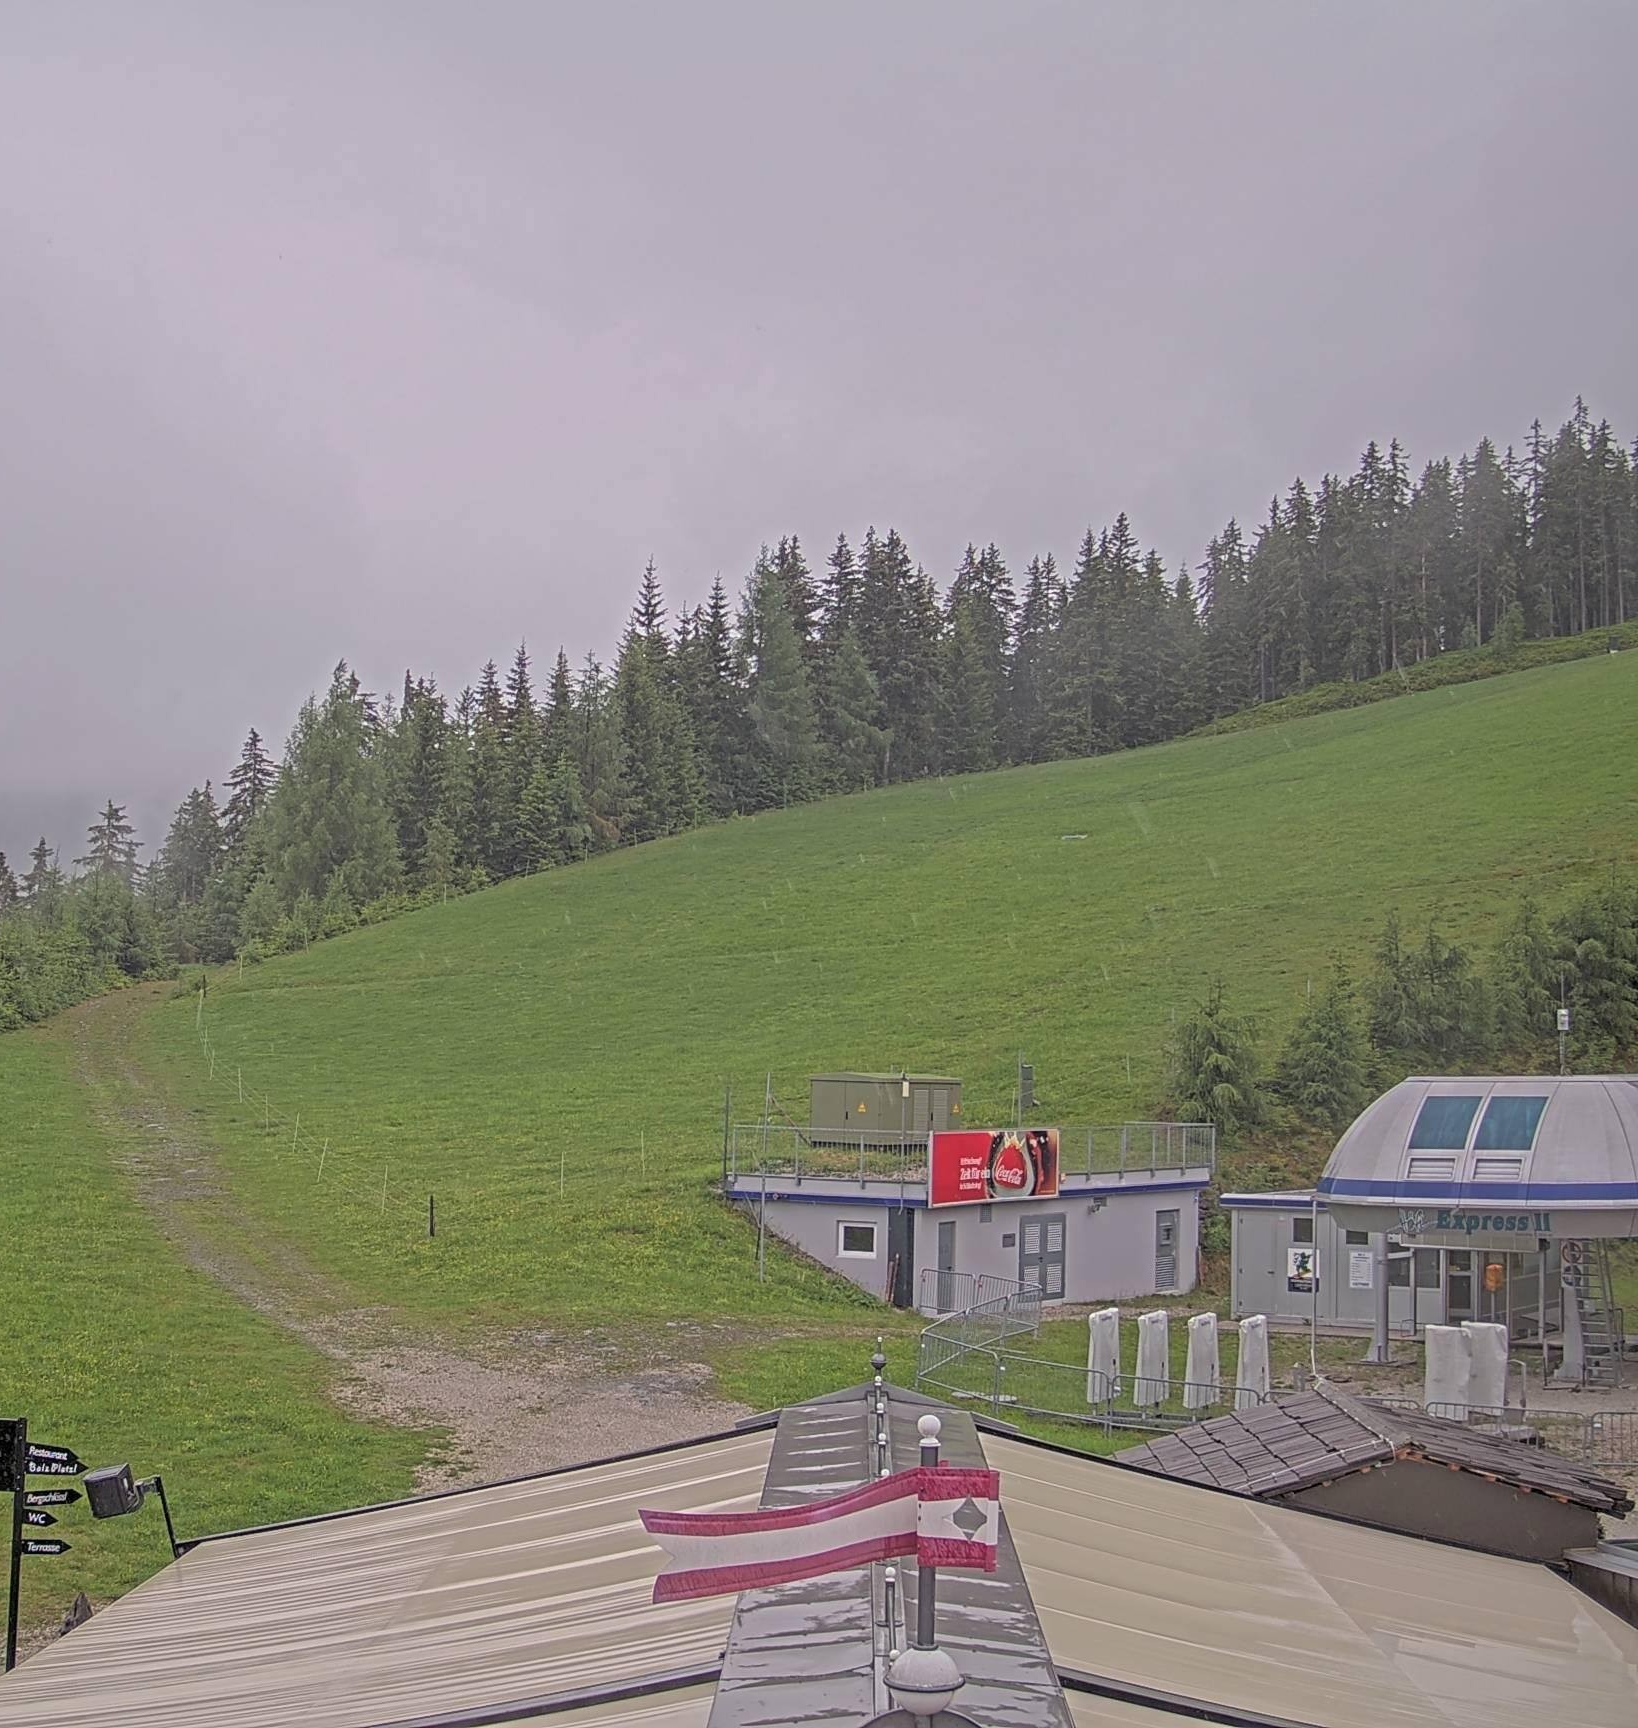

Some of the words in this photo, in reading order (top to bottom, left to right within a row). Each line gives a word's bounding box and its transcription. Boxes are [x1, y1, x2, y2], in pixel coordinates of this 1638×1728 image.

[1436, 1209, 1529, 1235] Express
[29, 1445, 68, 1460] Restaurant
[28, 1512, 46, 1524] WC
[27, 1541, 61, 1552] Terrasse
